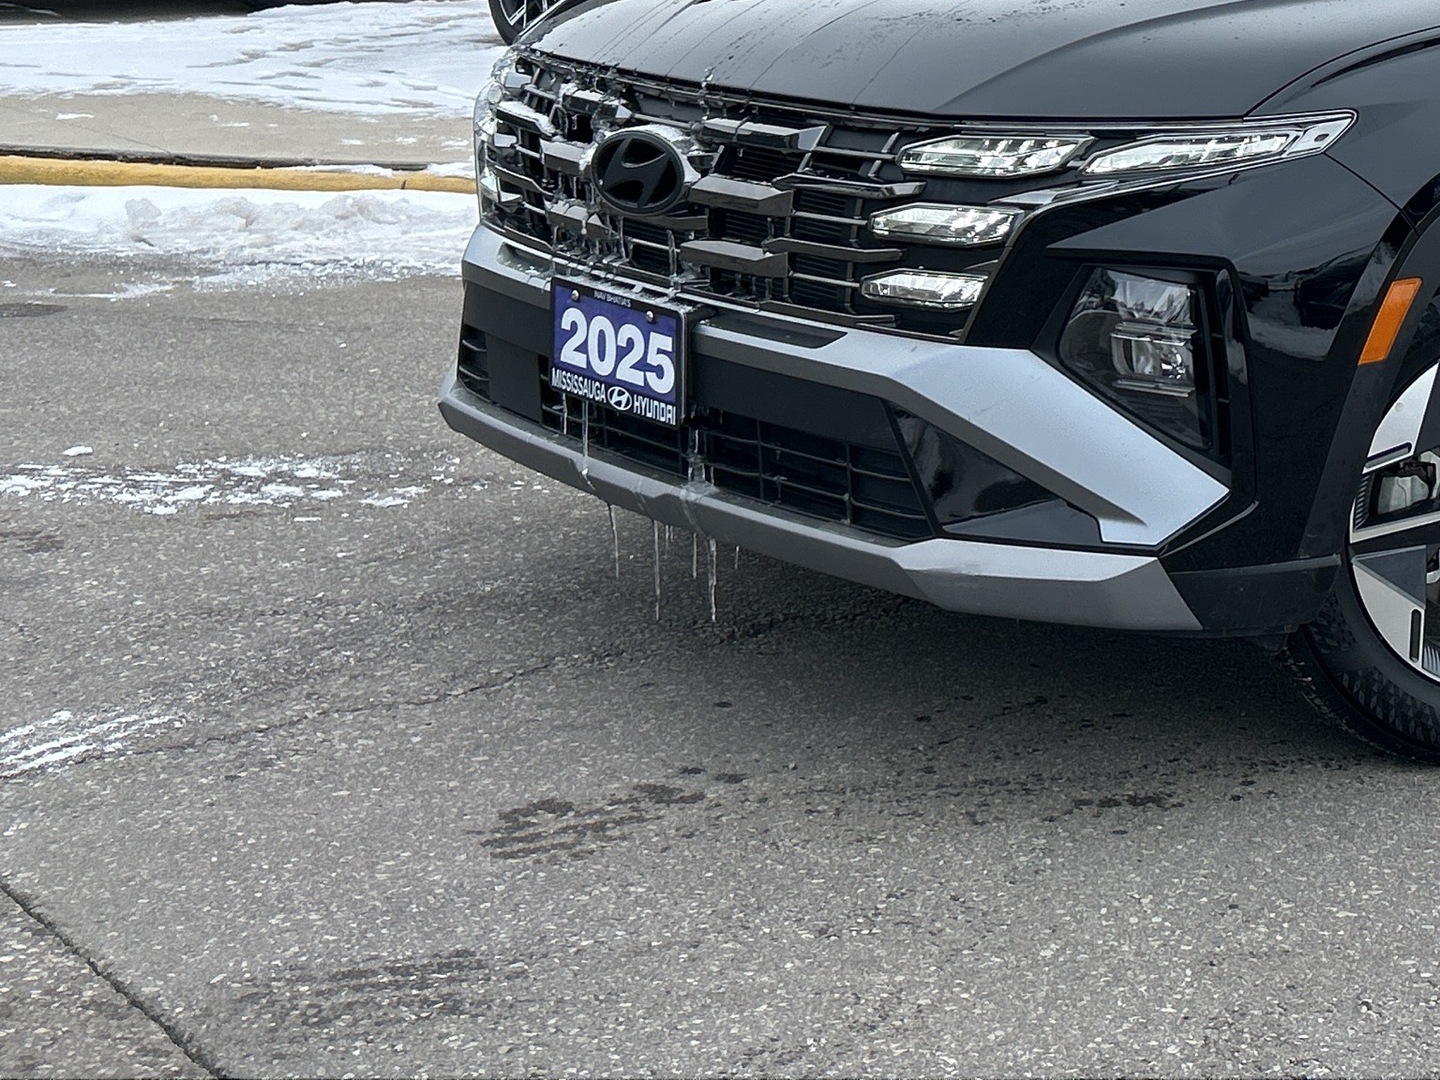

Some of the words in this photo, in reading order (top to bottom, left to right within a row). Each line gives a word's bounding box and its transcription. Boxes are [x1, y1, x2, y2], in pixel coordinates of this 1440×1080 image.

[560, 307, 675, 394] 2025
[551, 368, 607, 403] MISSISSAUGA
[633, 394, 677, 426] HYUNDAI
